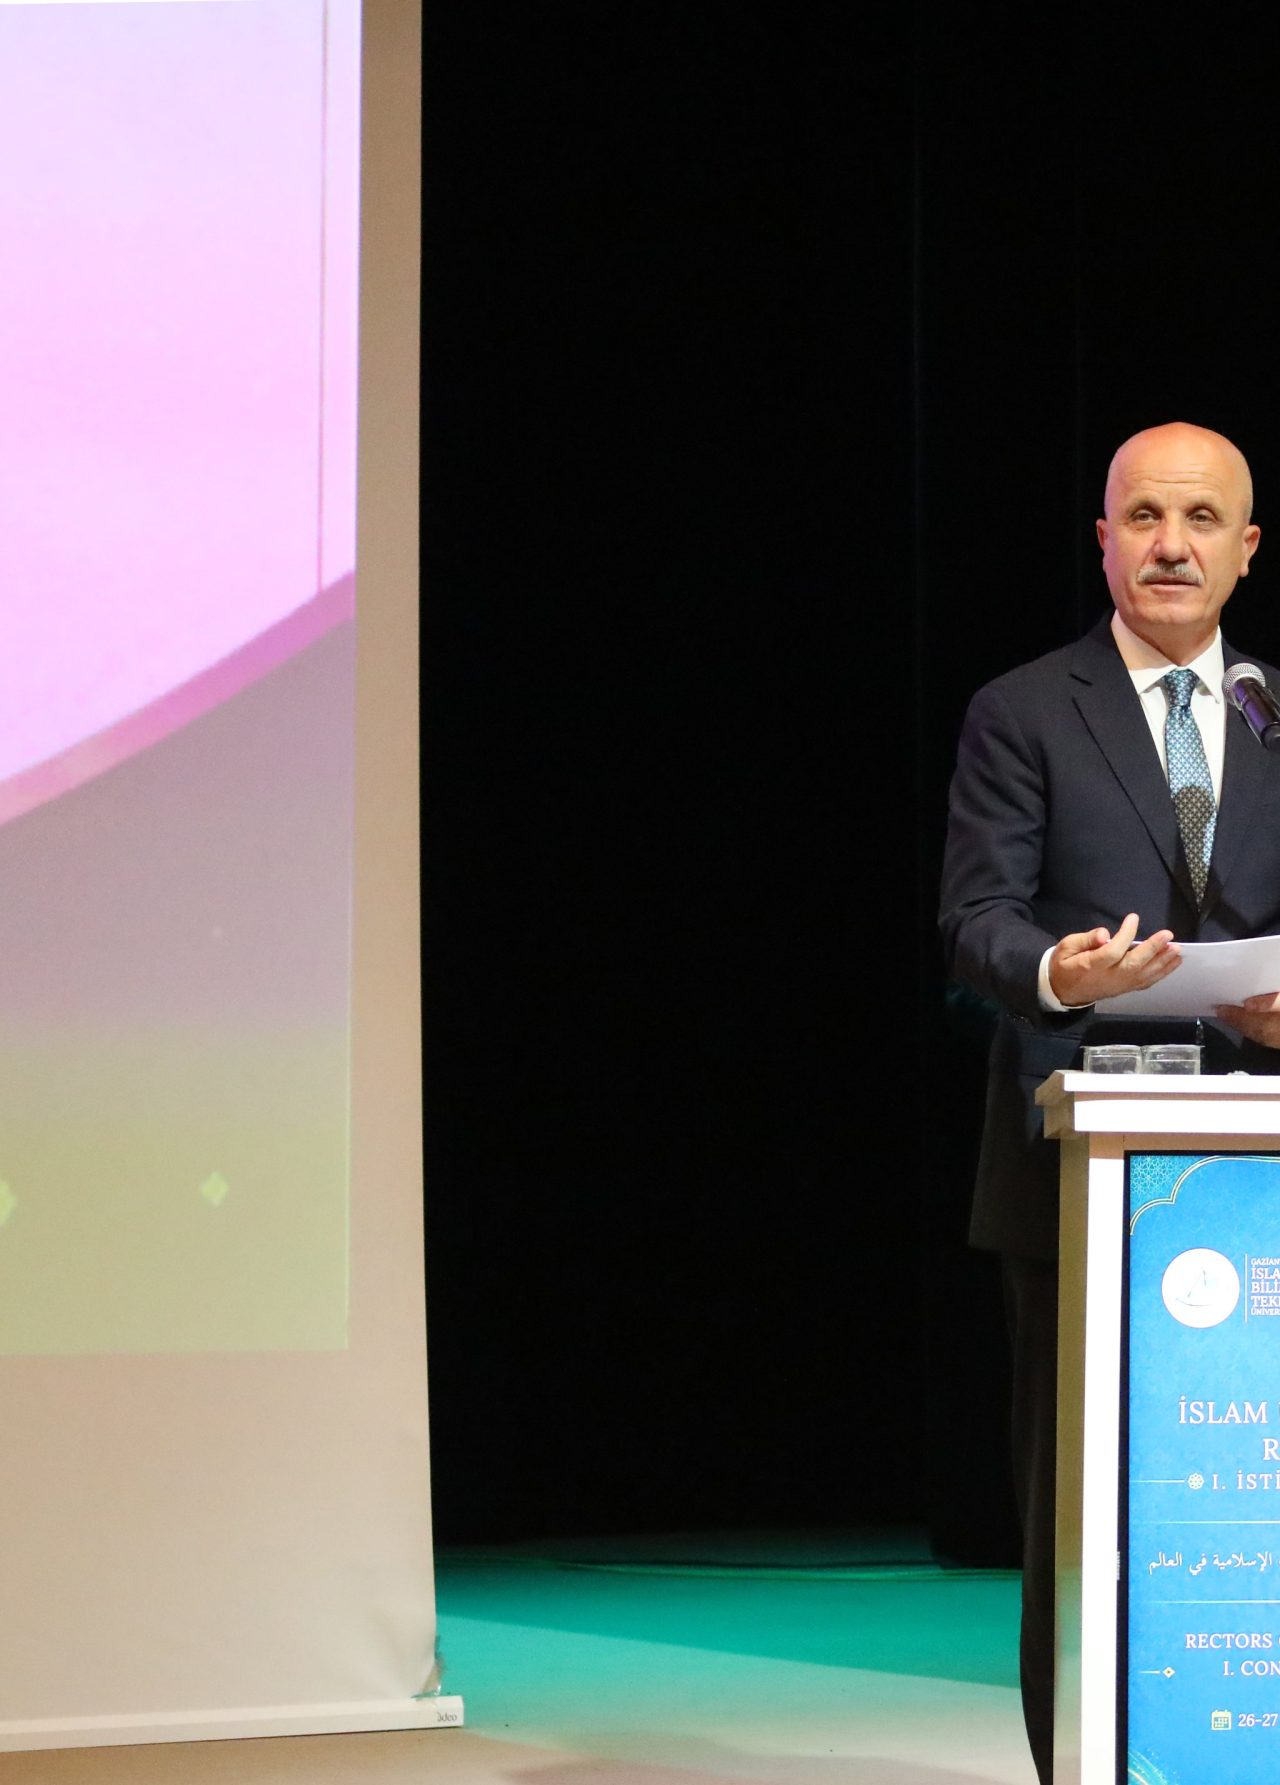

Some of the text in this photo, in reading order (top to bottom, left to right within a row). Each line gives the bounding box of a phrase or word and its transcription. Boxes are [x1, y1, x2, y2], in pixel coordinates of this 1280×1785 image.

[1179, 1396, 1268, 1424] İSLAM
[1213, 1474, 1225, 1489] I.
[1149, 1552, 1182, 1575] العالم
[1189, 1557, 1208, 1575] في
[1213, 1552, 1272, 1572] الإسلامية
[1186, 1633, 1273, 1648] RECTORS
[1224, 1661, 1234, 1676] I.
